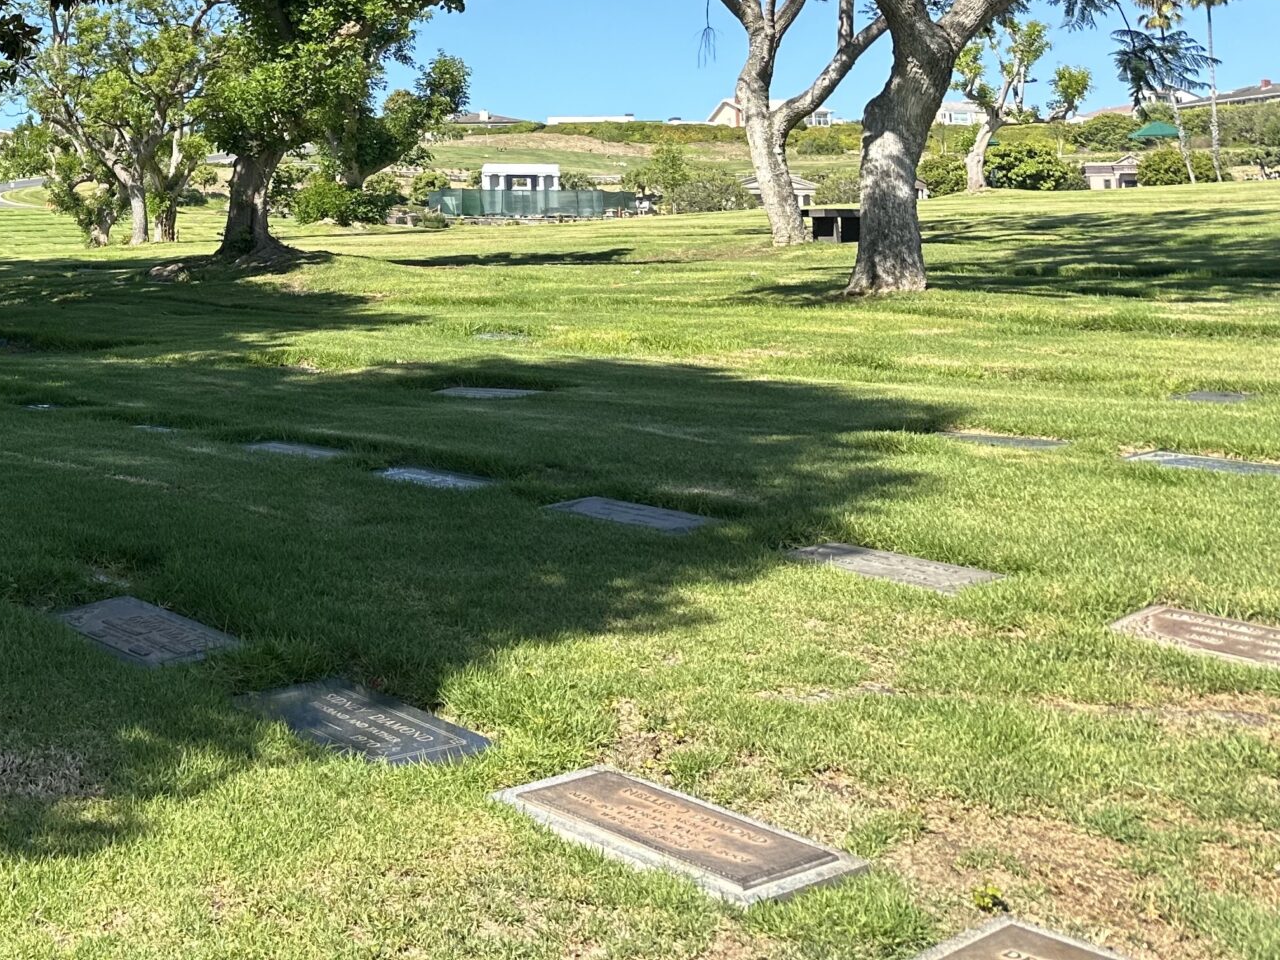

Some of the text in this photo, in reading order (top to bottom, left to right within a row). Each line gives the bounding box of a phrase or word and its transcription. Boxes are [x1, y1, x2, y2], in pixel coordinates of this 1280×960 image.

[322, 693, 434, 742] SIDNEY DIAMOND
[346, 719, 369, 729] AND
[366, 727, 401, 743] FATHER
[349, 735, 380, 748] 1970
[623, 788, 675, 810] NELLIE
[691, 814, 768, 844] DIAMOND
[625, 805, 667, 824] WORLD
[673, 824, 700, 838] WAR
